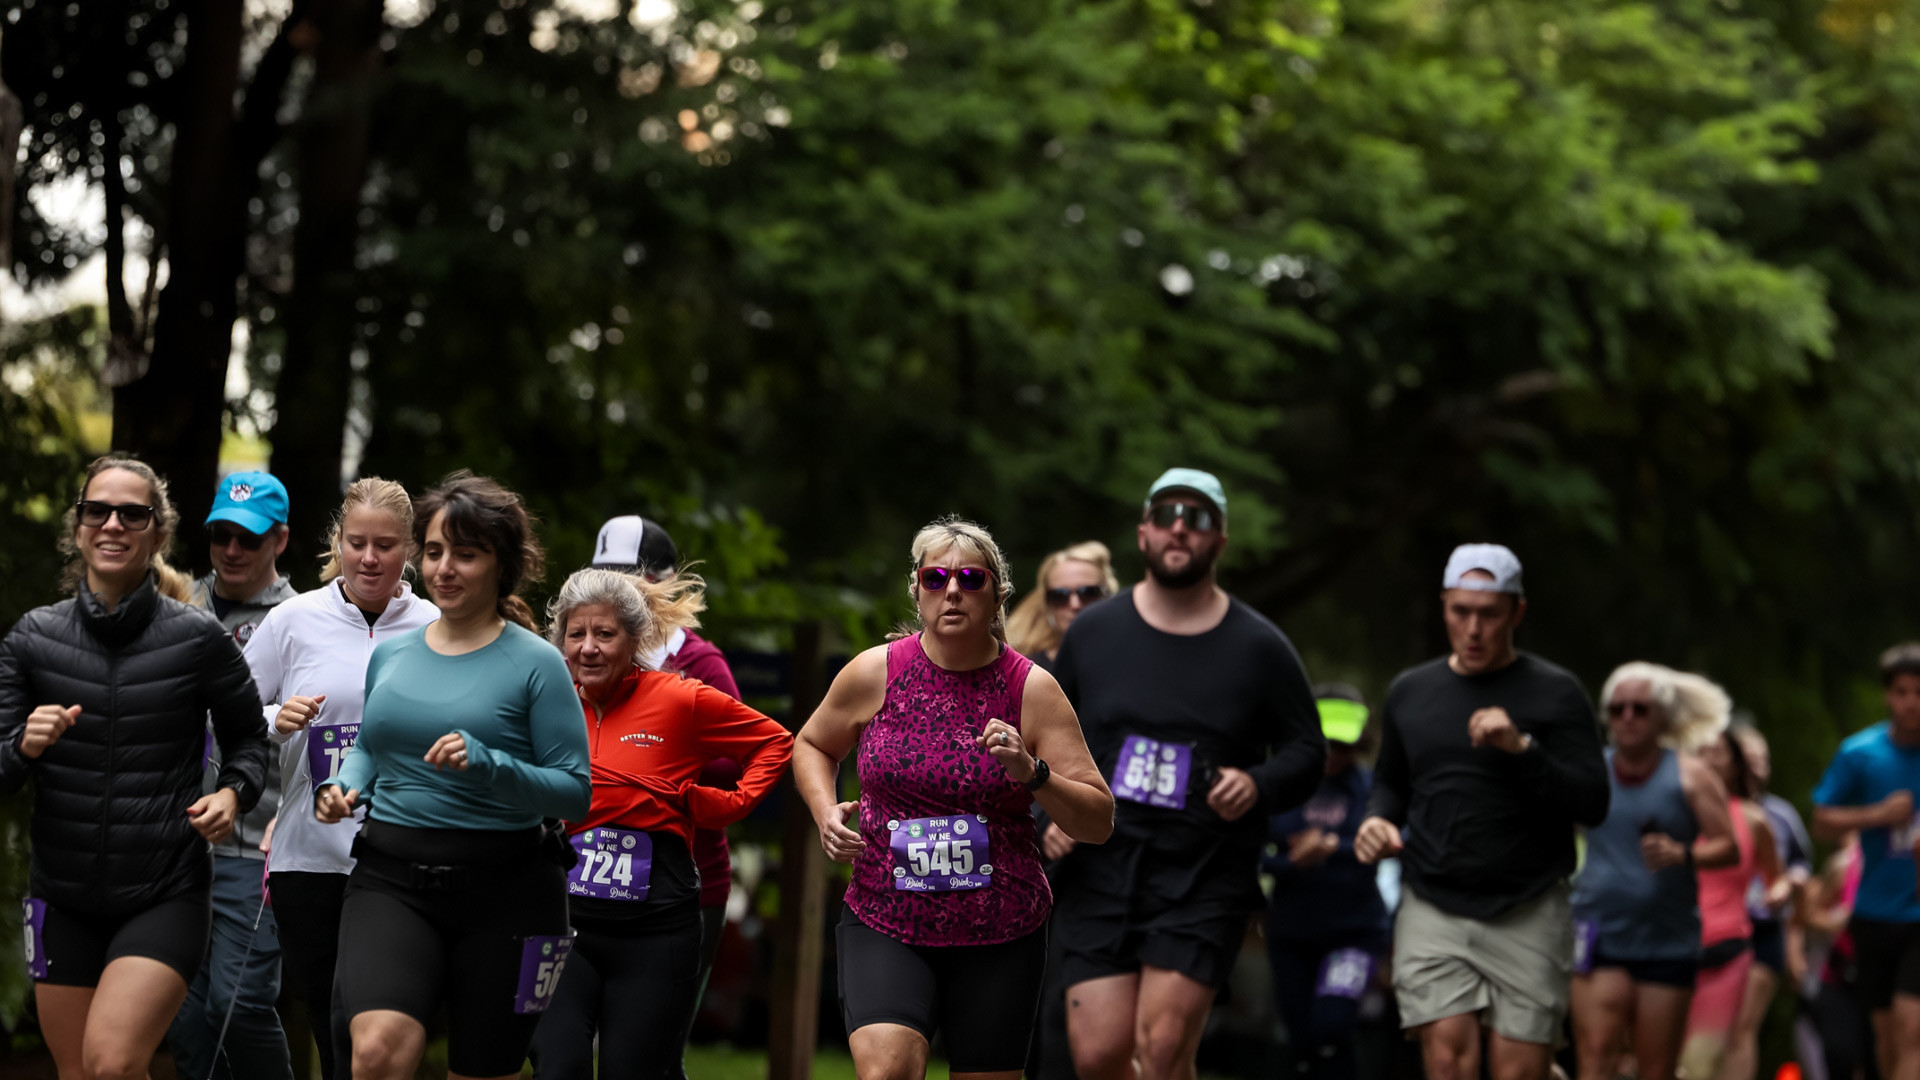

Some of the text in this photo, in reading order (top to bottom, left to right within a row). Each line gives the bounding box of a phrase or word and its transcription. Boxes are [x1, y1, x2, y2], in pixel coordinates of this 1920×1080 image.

[341, 725, 358, 734] RUN
[620, 733, 646, 742] BETTER
[929, 819, 949, 828] RUN
[600, 829, 618, 840] RUN
[907, 839, 974, 877] 545
[580, 848, 633, 887] 724
[569, 881, 589, 895] Drink
[904, 876, 928, 890] Drink
[949, 876, 974, 889] Drink
[609, 886, 632, 900] Drink
